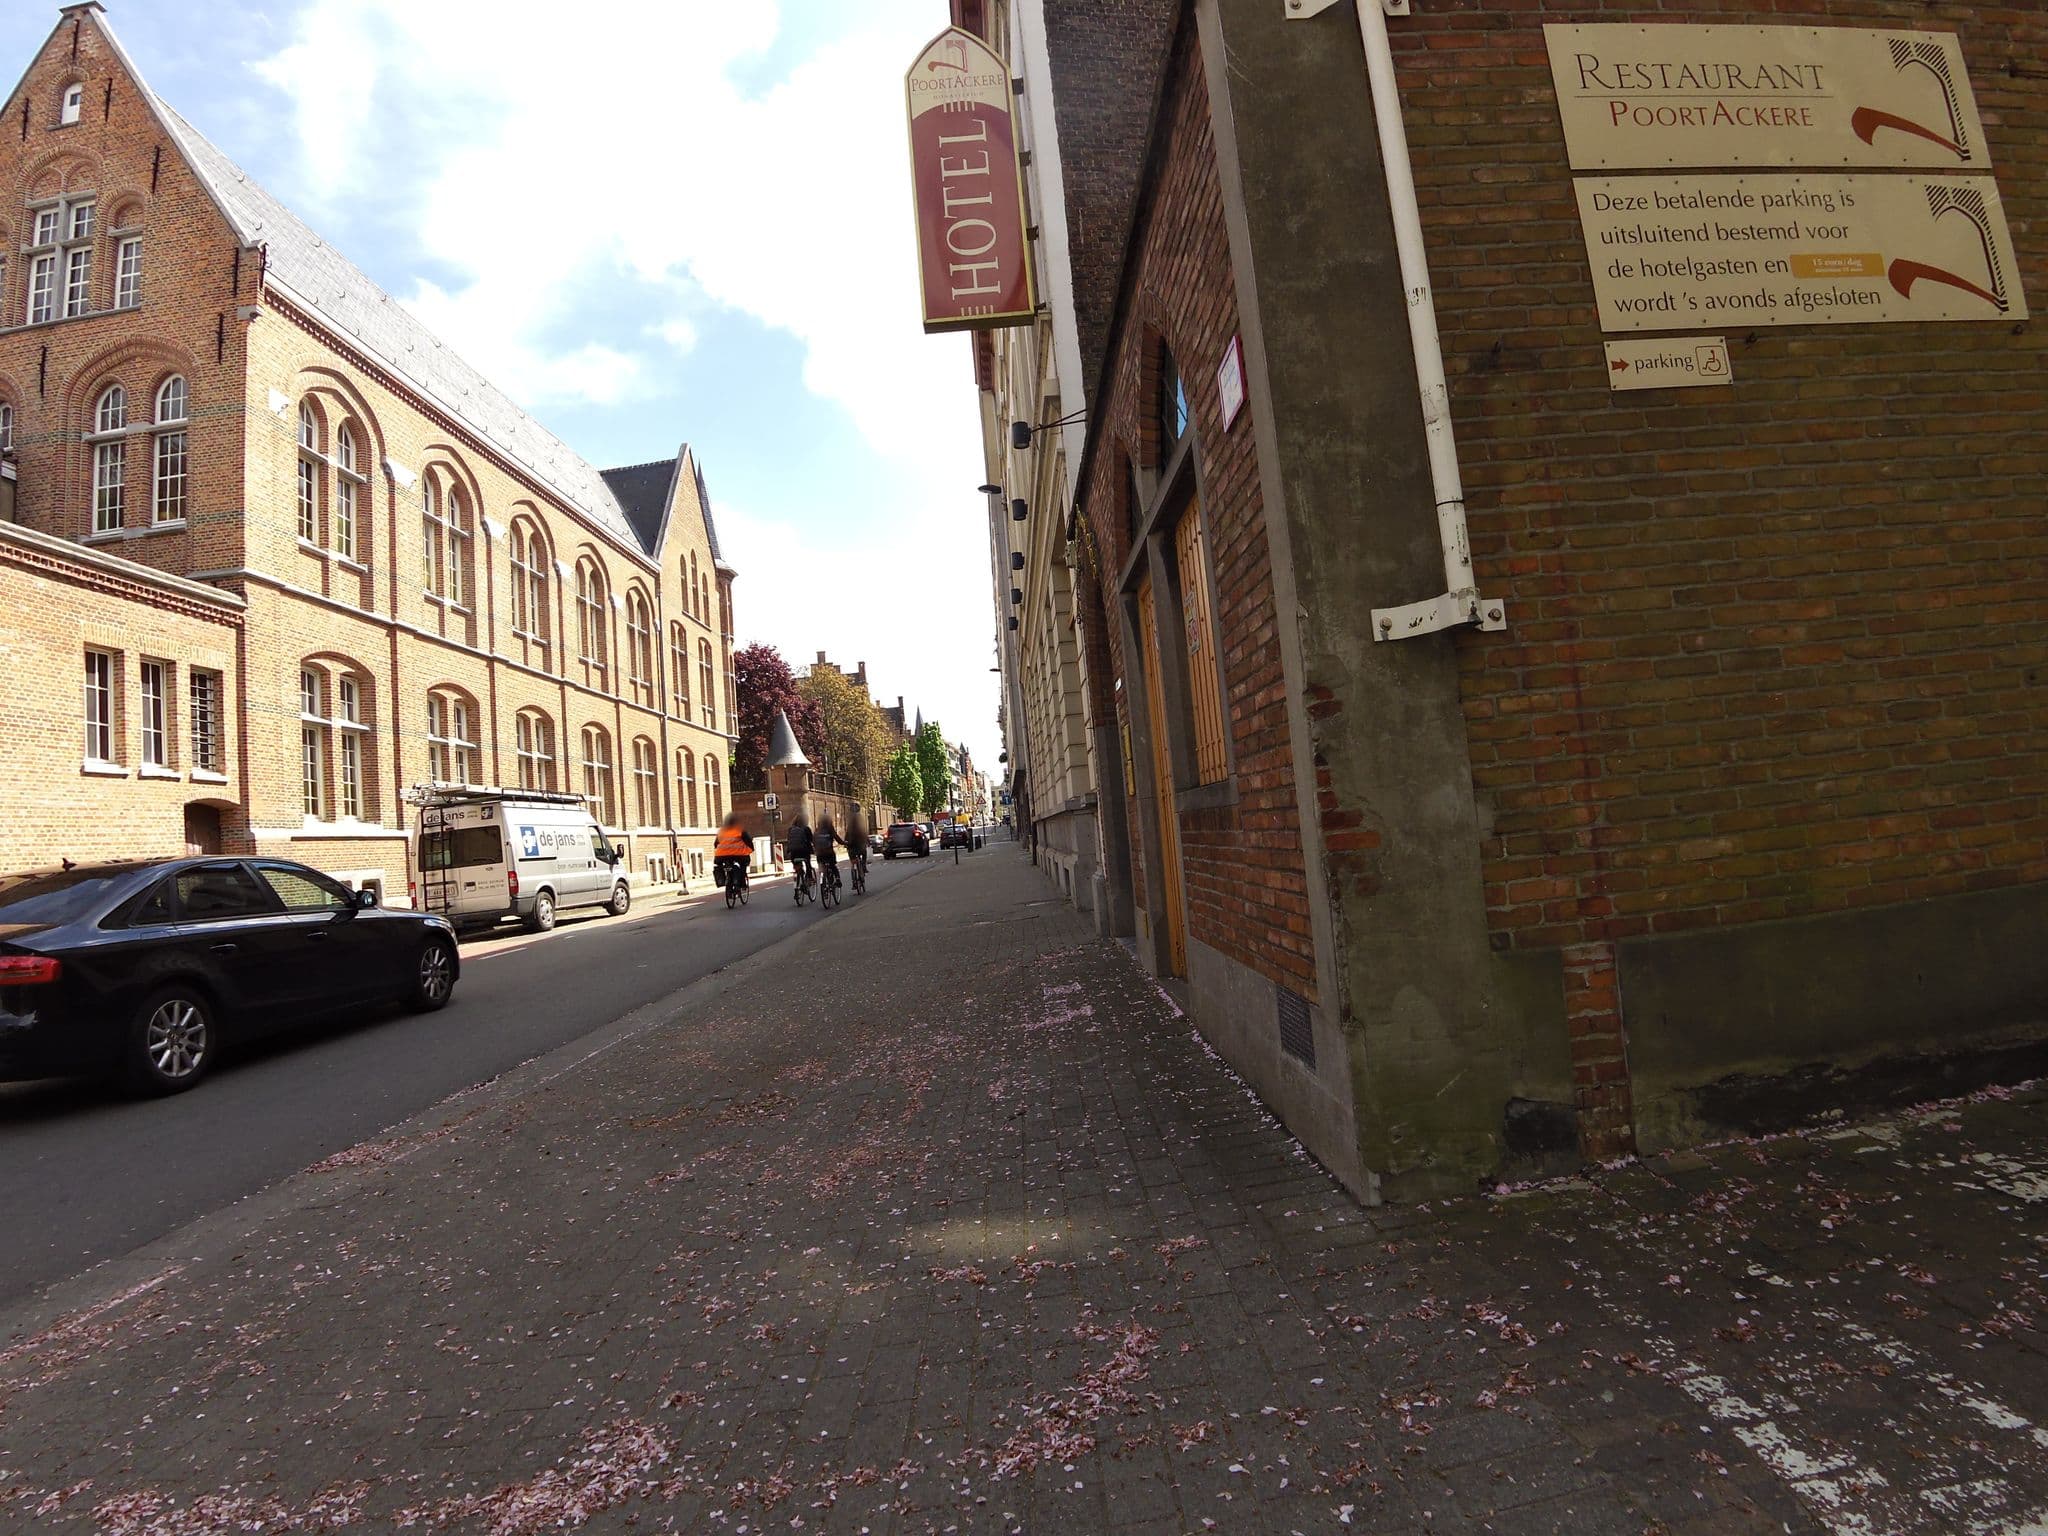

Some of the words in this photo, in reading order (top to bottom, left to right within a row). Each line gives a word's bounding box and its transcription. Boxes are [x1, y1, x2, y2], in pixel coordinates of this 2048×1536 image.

[1574, 53, 1824, 90] RESTAURANT
[938, 118, 1001, 300] HOTEL
[1593, 192, 1649, 211] Deze
[1654, 188, 1755, 210] betalende
[1761, 188, 1835, 213] parking
[1840, 189, 1855, 207] is
[1601, 222, 1709, 245] uitsluitend
[1715, 221, 1800, 241] bestemd
[1805, 224, 1849, 240] voor
[1608, 258, 1634, 279] de
[1641, 256, 1758, 281] hotelgasten
[1764, 258, 1788, 273] en
[1614, 291, 1677, 313] wordt
[1705, 287, 1777, 310] avonds
[1784, 286, 1881, 312] afgesloten
[1634, 353, 1694, 374] parking
[539, 830, 553, 847] de
[554, 830, 576, 850] jans
